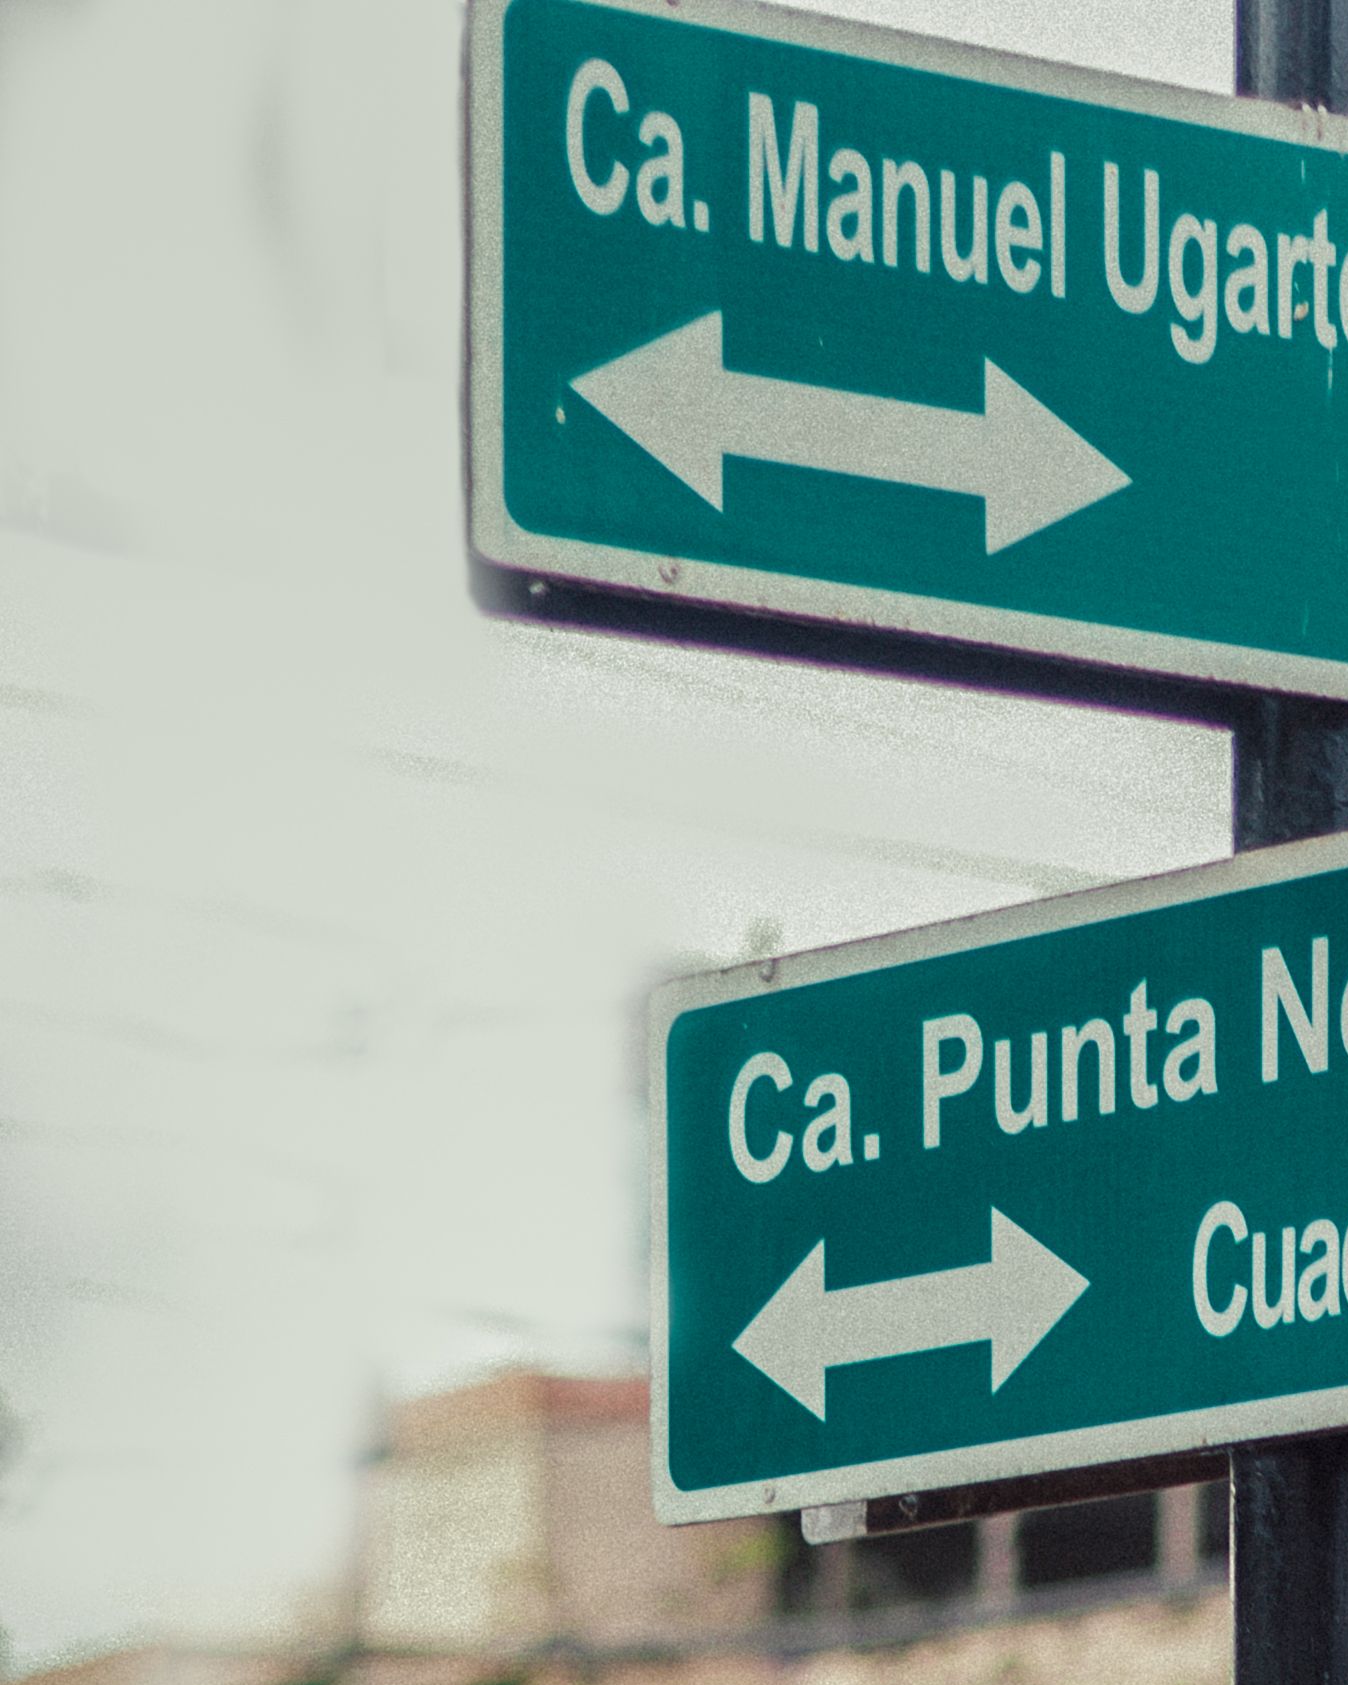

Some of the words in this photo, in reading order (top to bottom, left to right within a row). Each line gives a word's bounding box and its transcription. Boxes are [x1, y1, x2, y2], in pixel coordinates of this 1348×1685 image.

[565, 58, 710, 233] Ca.
[748, 92, 1066, 298] Manuel
[728, 1051, 881, 1183] Ca.
[923, 982, 1218, 1149] Punta
